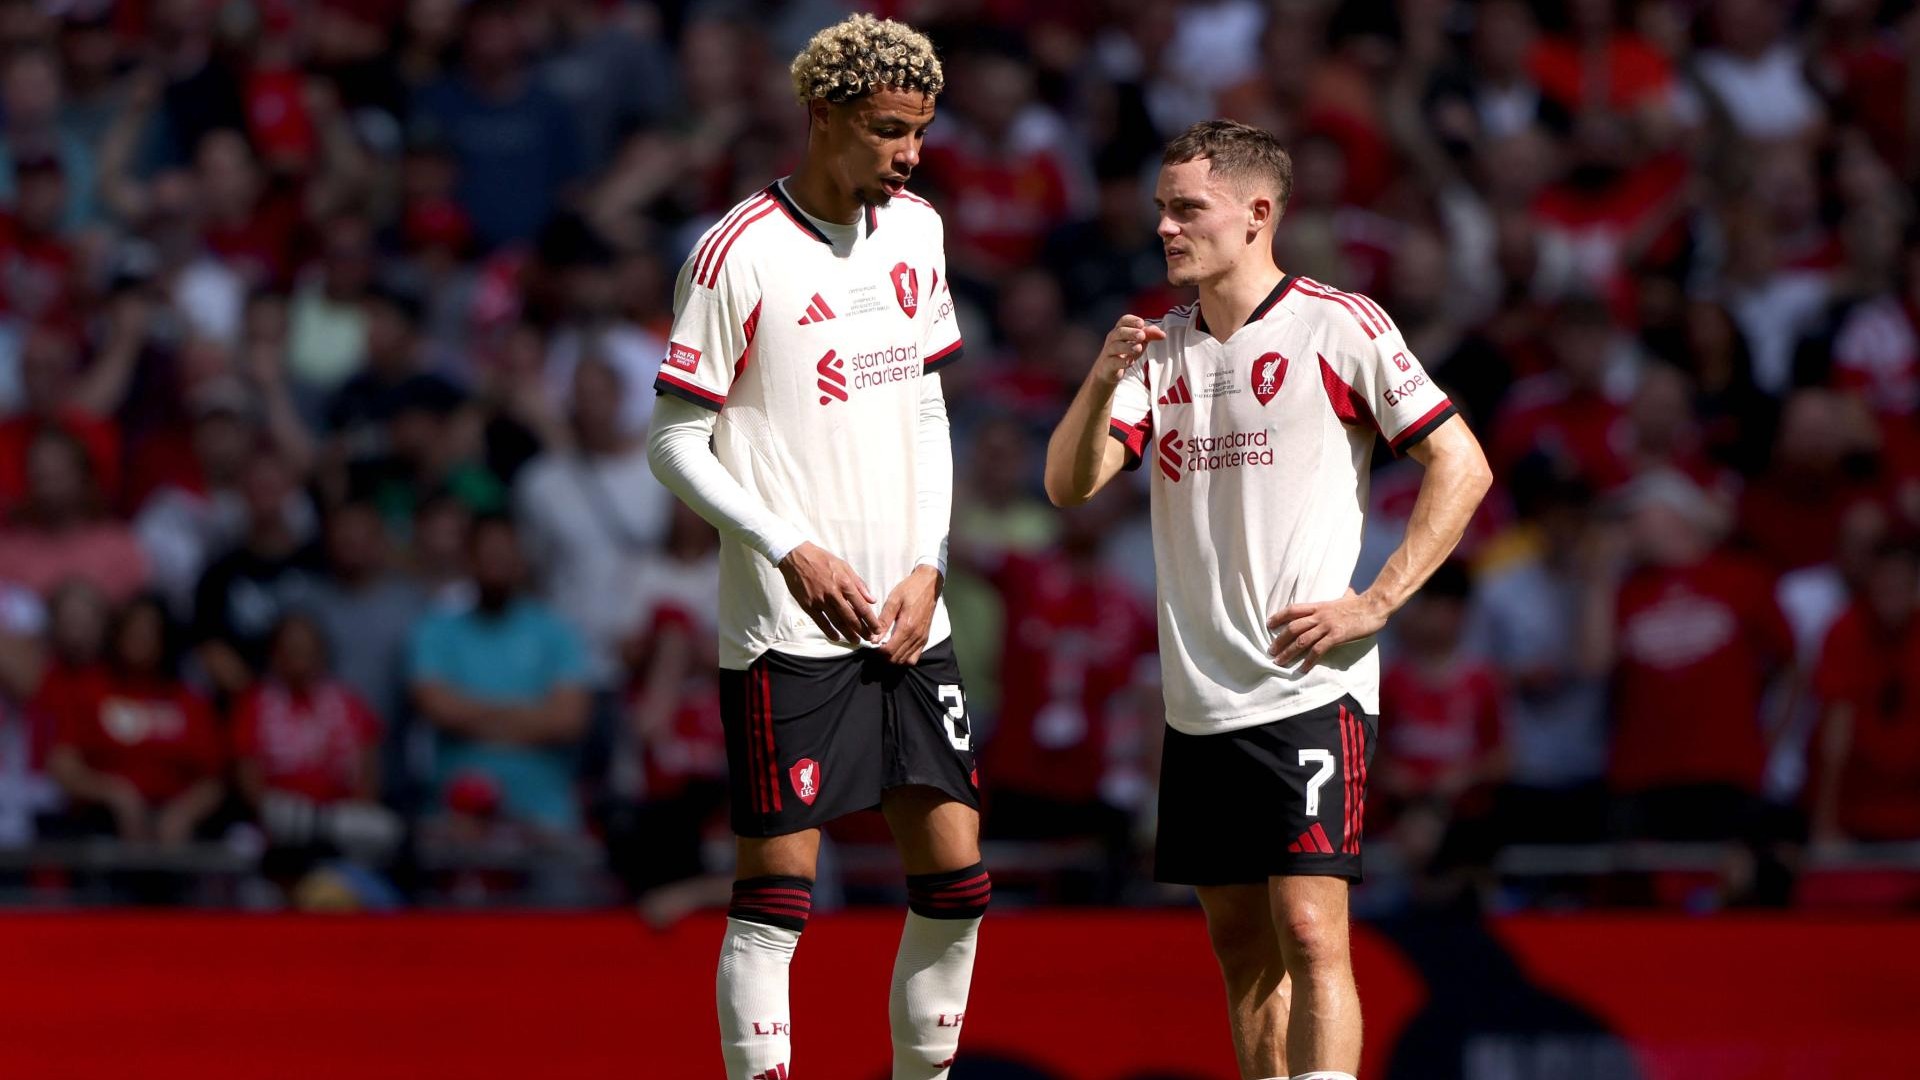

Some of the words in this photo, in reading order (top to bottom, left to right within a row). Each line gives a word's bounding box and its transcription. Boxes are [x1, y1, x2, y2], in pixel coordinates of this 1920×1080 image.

[852, 342, 918, 371] standard
[855, 362, 920, 390] chartered
[1383, 370, 1428, 407] Expe
[1187, 428, 1268, 453] standard
[1187, 448, 1274, 472] chartered
[938, 684, 973, 752] 2
[1298, 748, 1335, 817] 7
